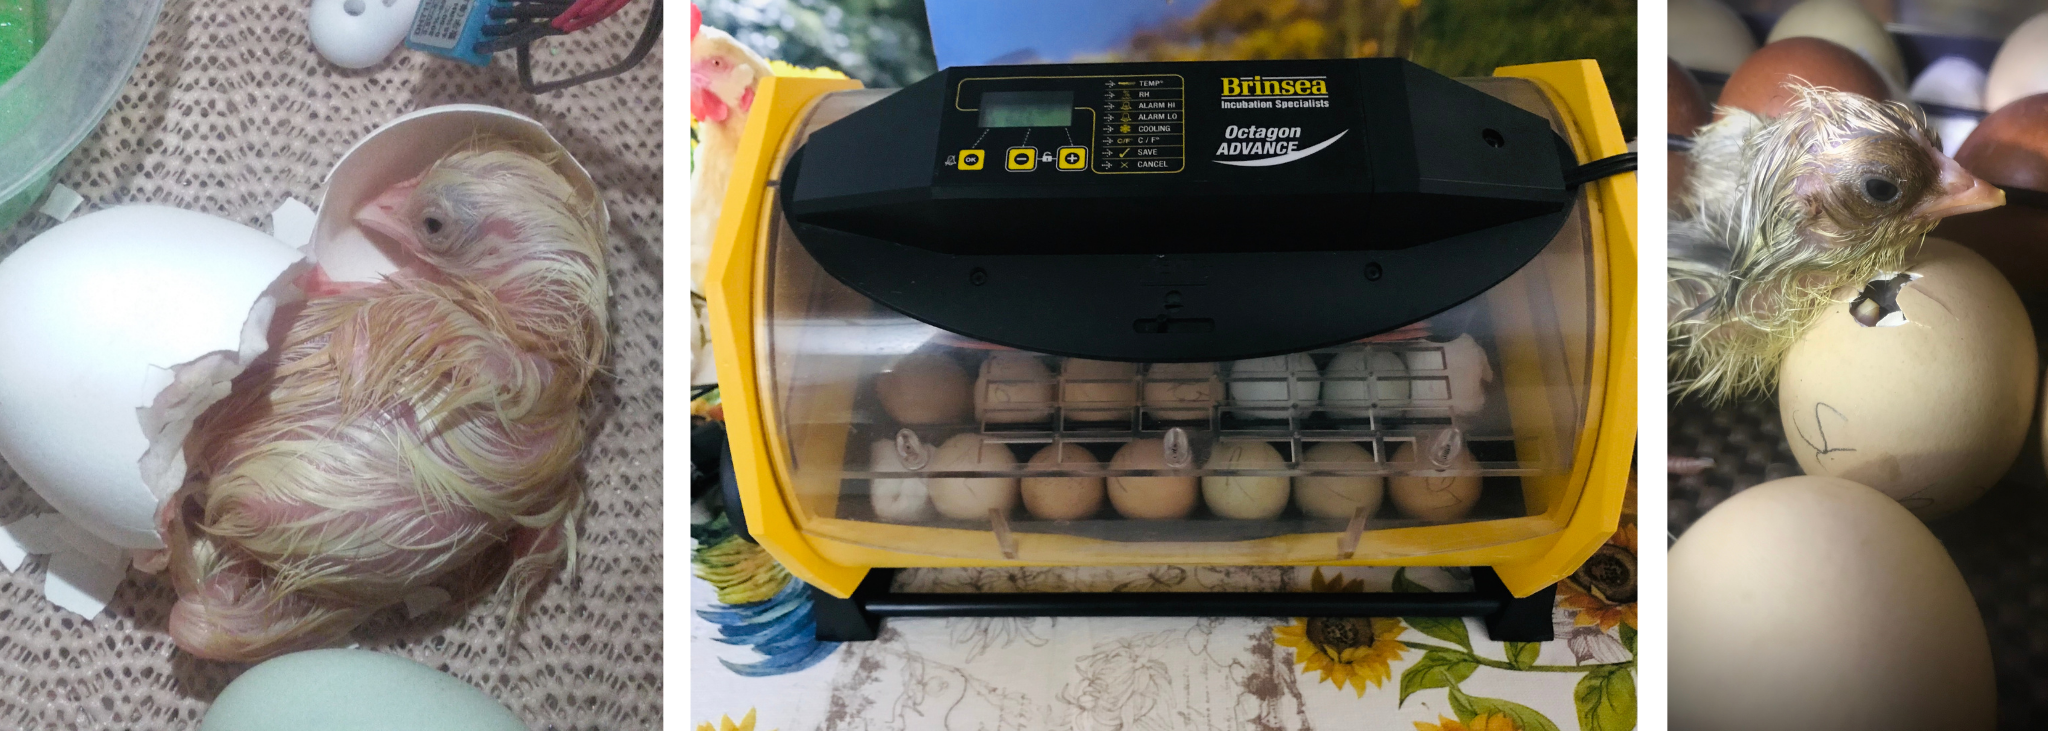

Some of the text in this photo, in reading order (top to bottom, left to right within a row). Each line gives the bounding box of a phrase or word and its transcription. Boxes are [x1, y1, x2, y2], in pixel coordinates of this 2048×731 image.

[1221, 76, 1328, 96] Brinsea
[1221, 99, 1330, 109] Incubation Specialists
[1138, 125, 1171, 133] COOLING
[1225, 125, 1301, 141] Octagon
[1137, 148, 1158, 156] SAVE
[1216, 141, 1299, 156] ADVANCE
